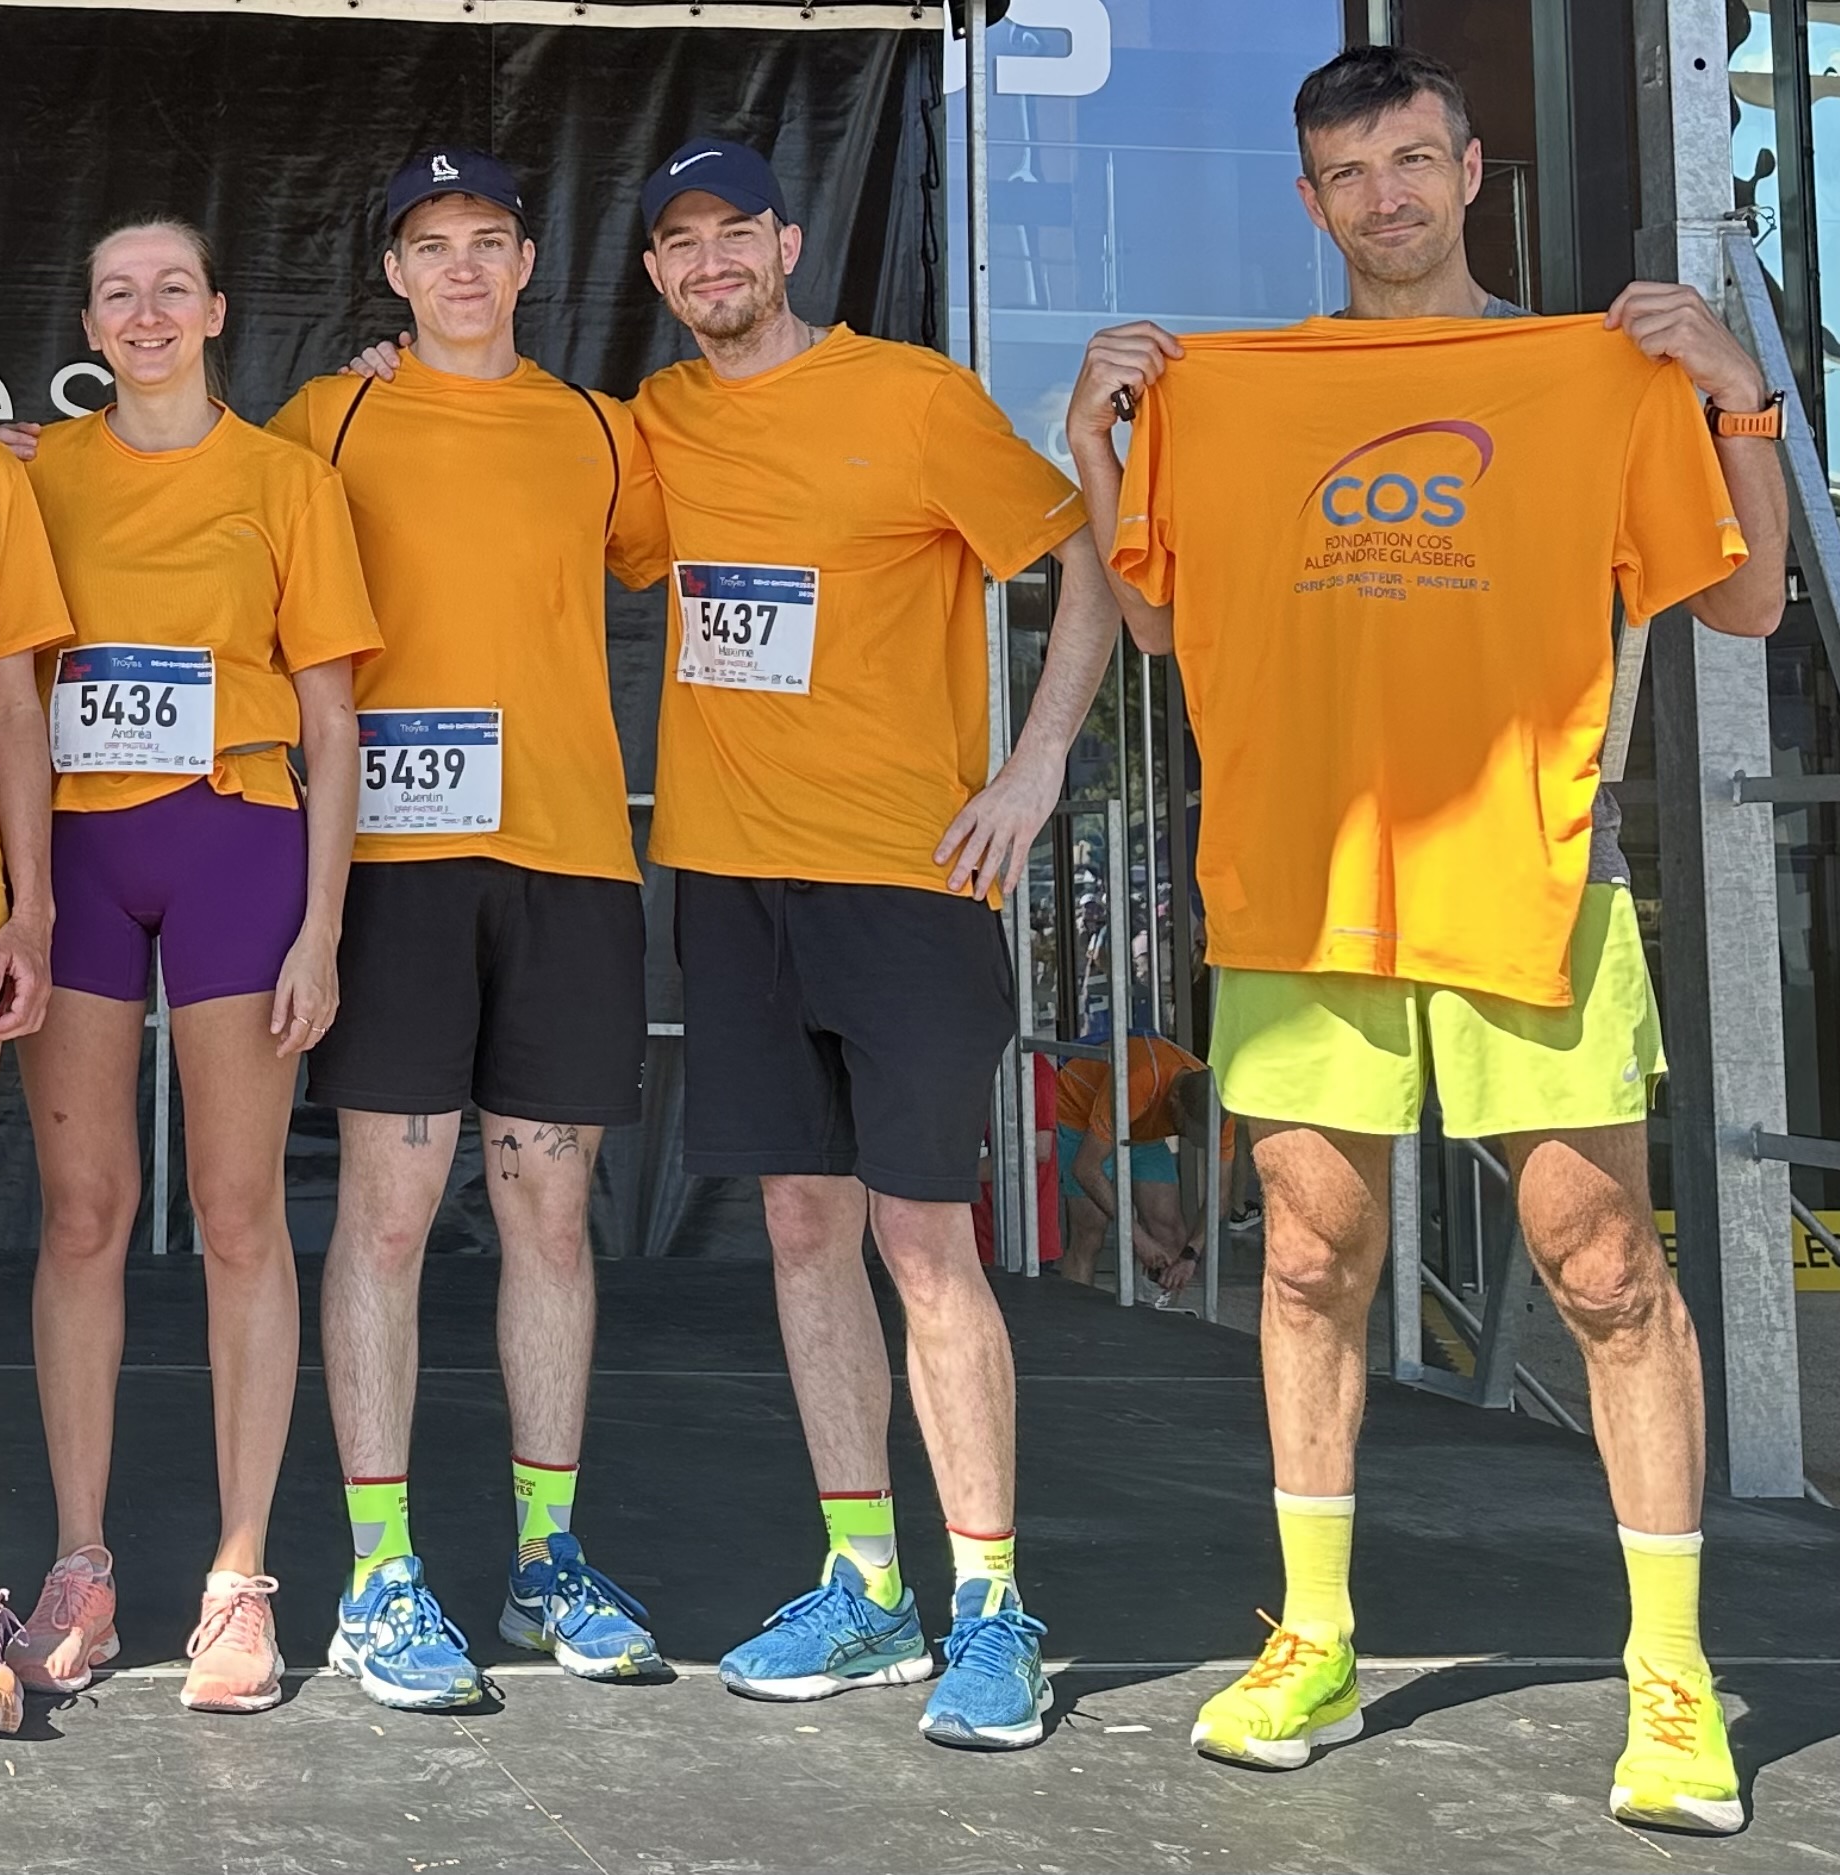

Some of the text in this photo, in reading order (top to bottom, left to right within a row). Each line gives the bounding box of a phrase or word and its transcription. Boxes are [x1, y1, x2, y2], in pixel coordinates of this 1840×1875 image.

[1321, 472, 1466, 528] COS
[1325, 531, 1453, 551] FONDATION COS
[1304, 548, 1476, 571] ALEXANDRE GLASBERG
[1346, 572, 1404, 586] PASTEUR
[1417, 575, 1478, 590] PASTEUR
[701, 601, 778, 646] 5437
[80, 684, 177, 728] 5436
[111, 726, 152, 740] Andréa
[366, 748, 466, 790] 5439
[400, 792, 444, 803] Quentin
